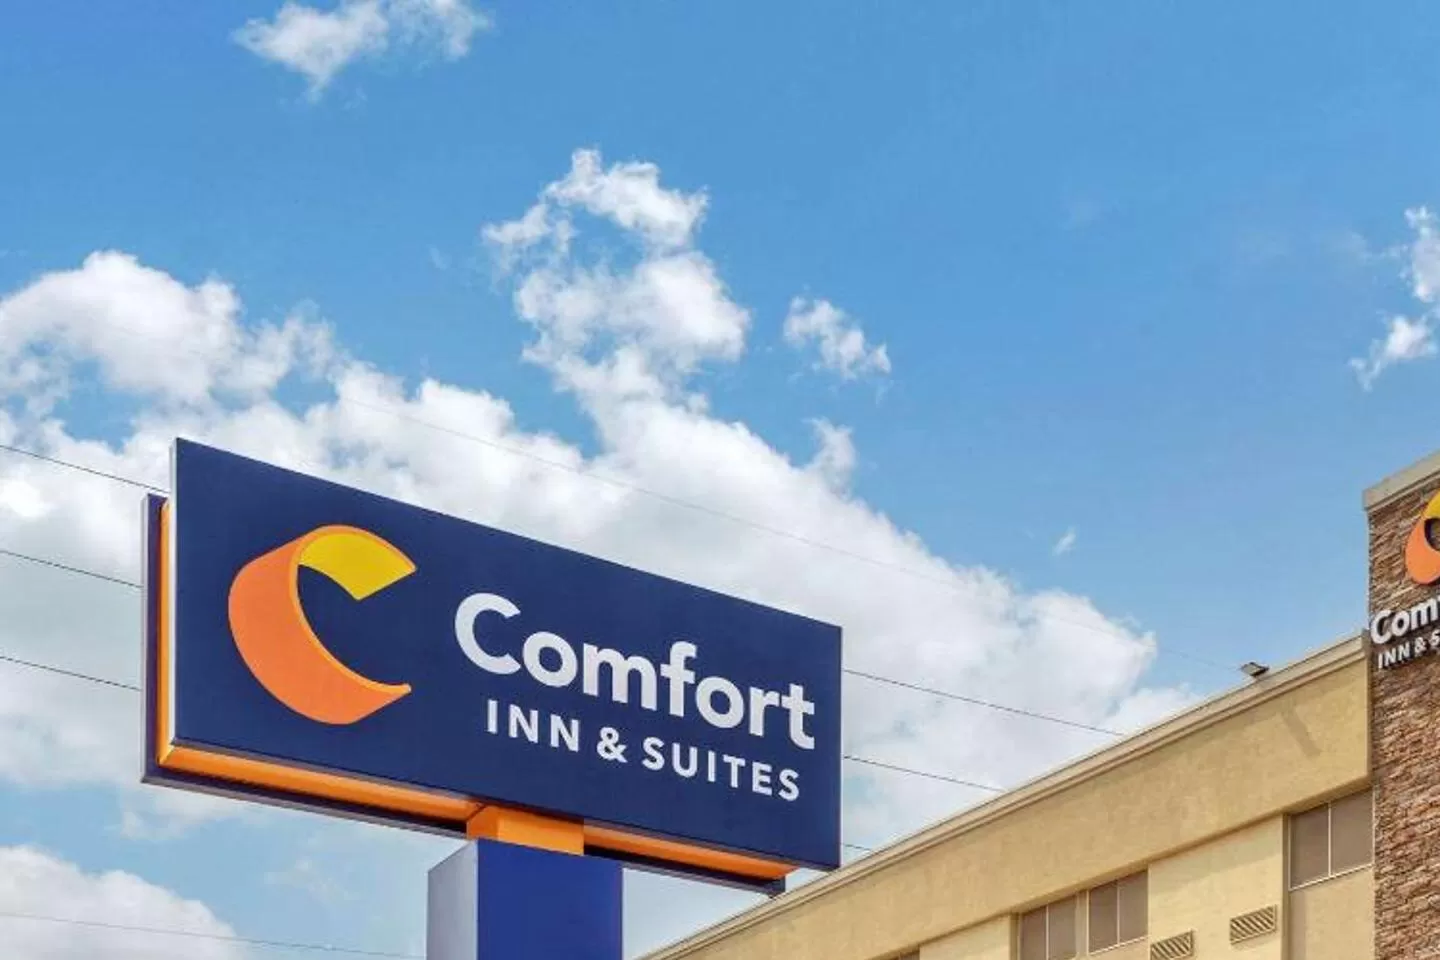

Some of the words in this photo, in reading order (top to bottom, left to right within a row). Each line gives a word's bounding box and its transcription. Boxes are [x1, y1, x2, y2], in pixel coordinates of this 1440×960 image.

[454, 592, 816, 750] Comfort
[1378, 642, 1411, 669] INN
[1413, 636, 1427, 655] &
[486, 699, 580, 752] INN
[596, 727, 628, 764] &
[641, 736, 801, 801] SUITES
